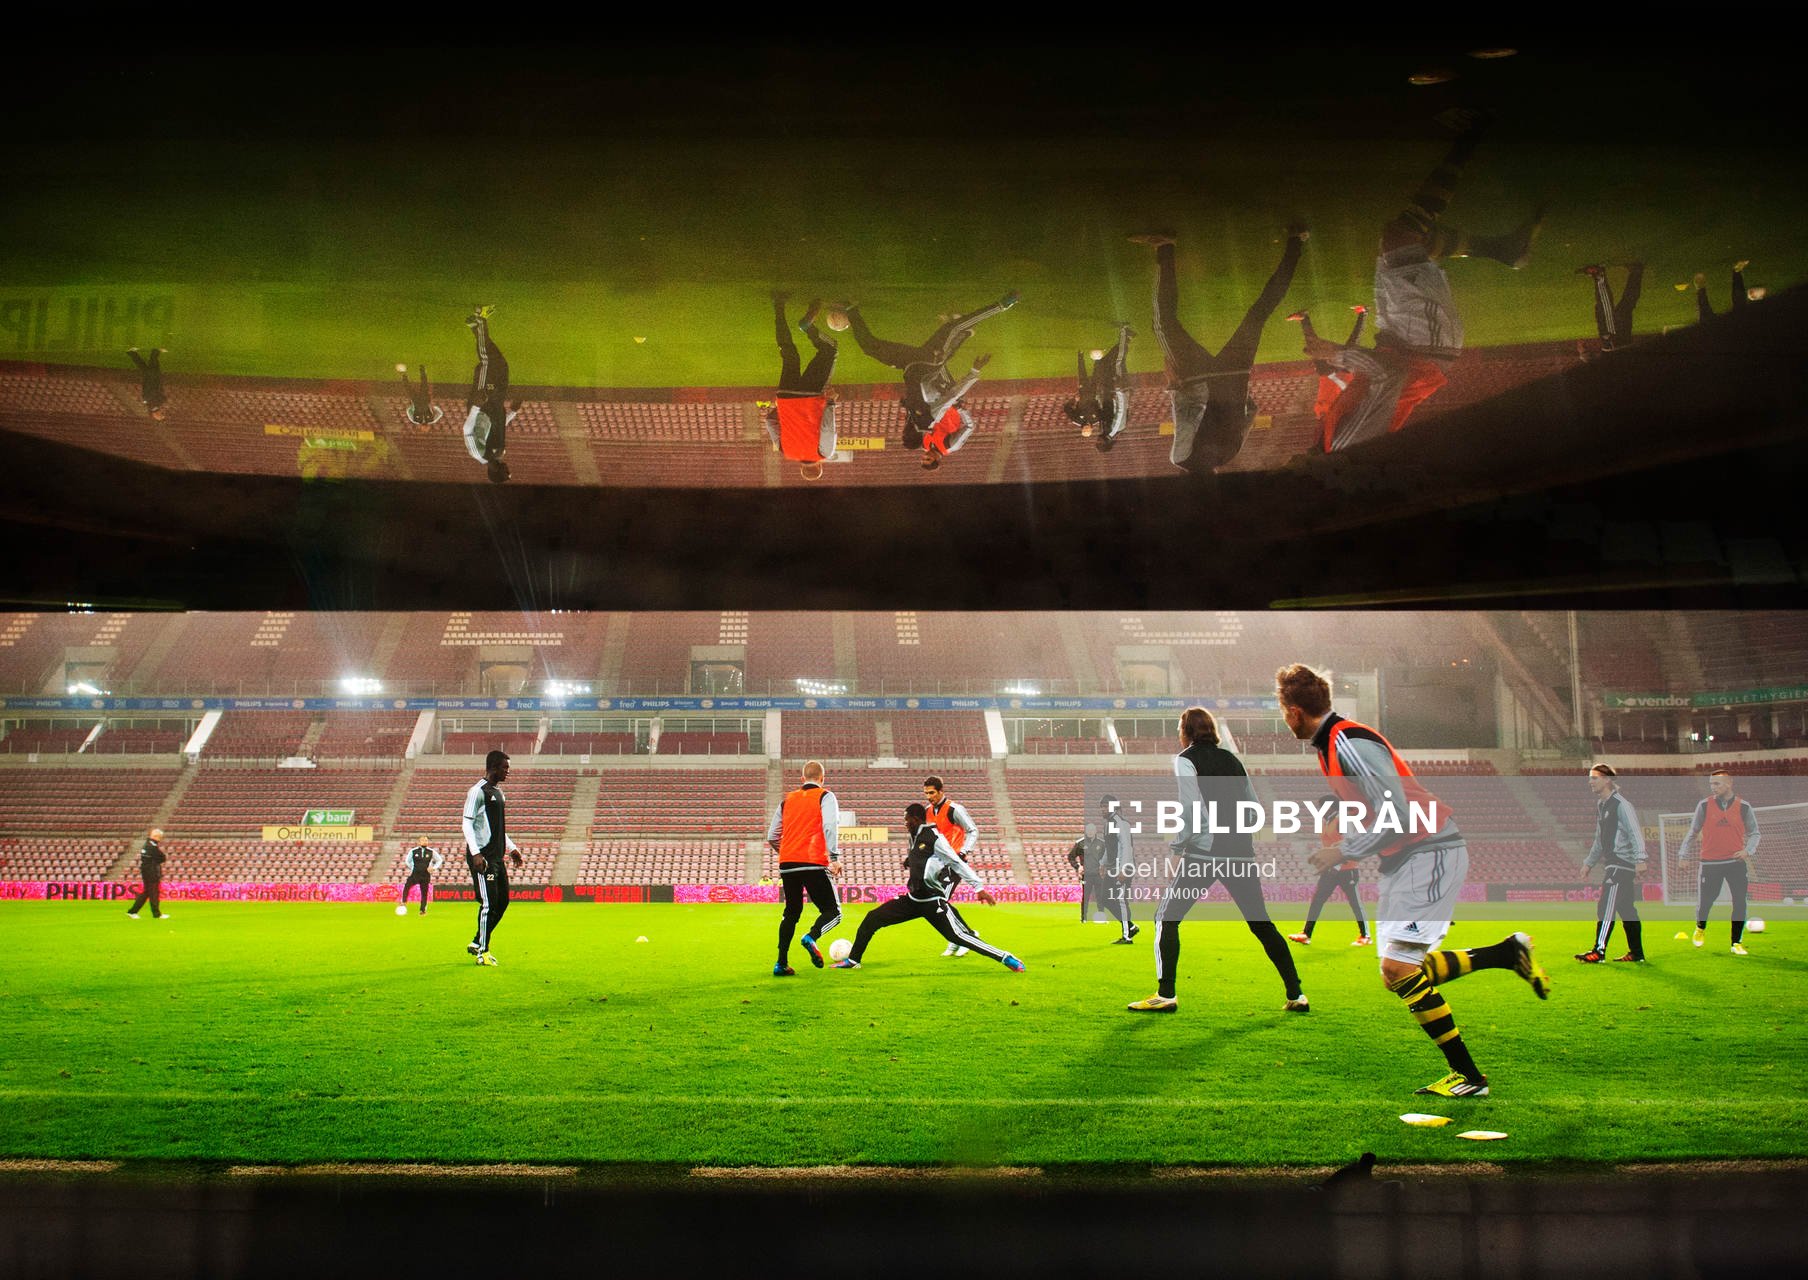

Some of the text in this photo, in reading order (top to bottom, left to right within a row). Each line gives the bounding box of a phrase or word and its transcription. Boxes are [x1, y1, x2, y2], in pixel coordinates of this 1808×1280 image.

[1639, 695, 1690, 706] vendor
[277, 827, 358, 840] Oad Reizen.nl
[838, 829, 872, 841] zen.nl
[47, 883, 329, 901] PHILIPS sense and simplicity
[435, 890, 460, 900] UEFA
[508, 890, 541, 900] EAGUE
